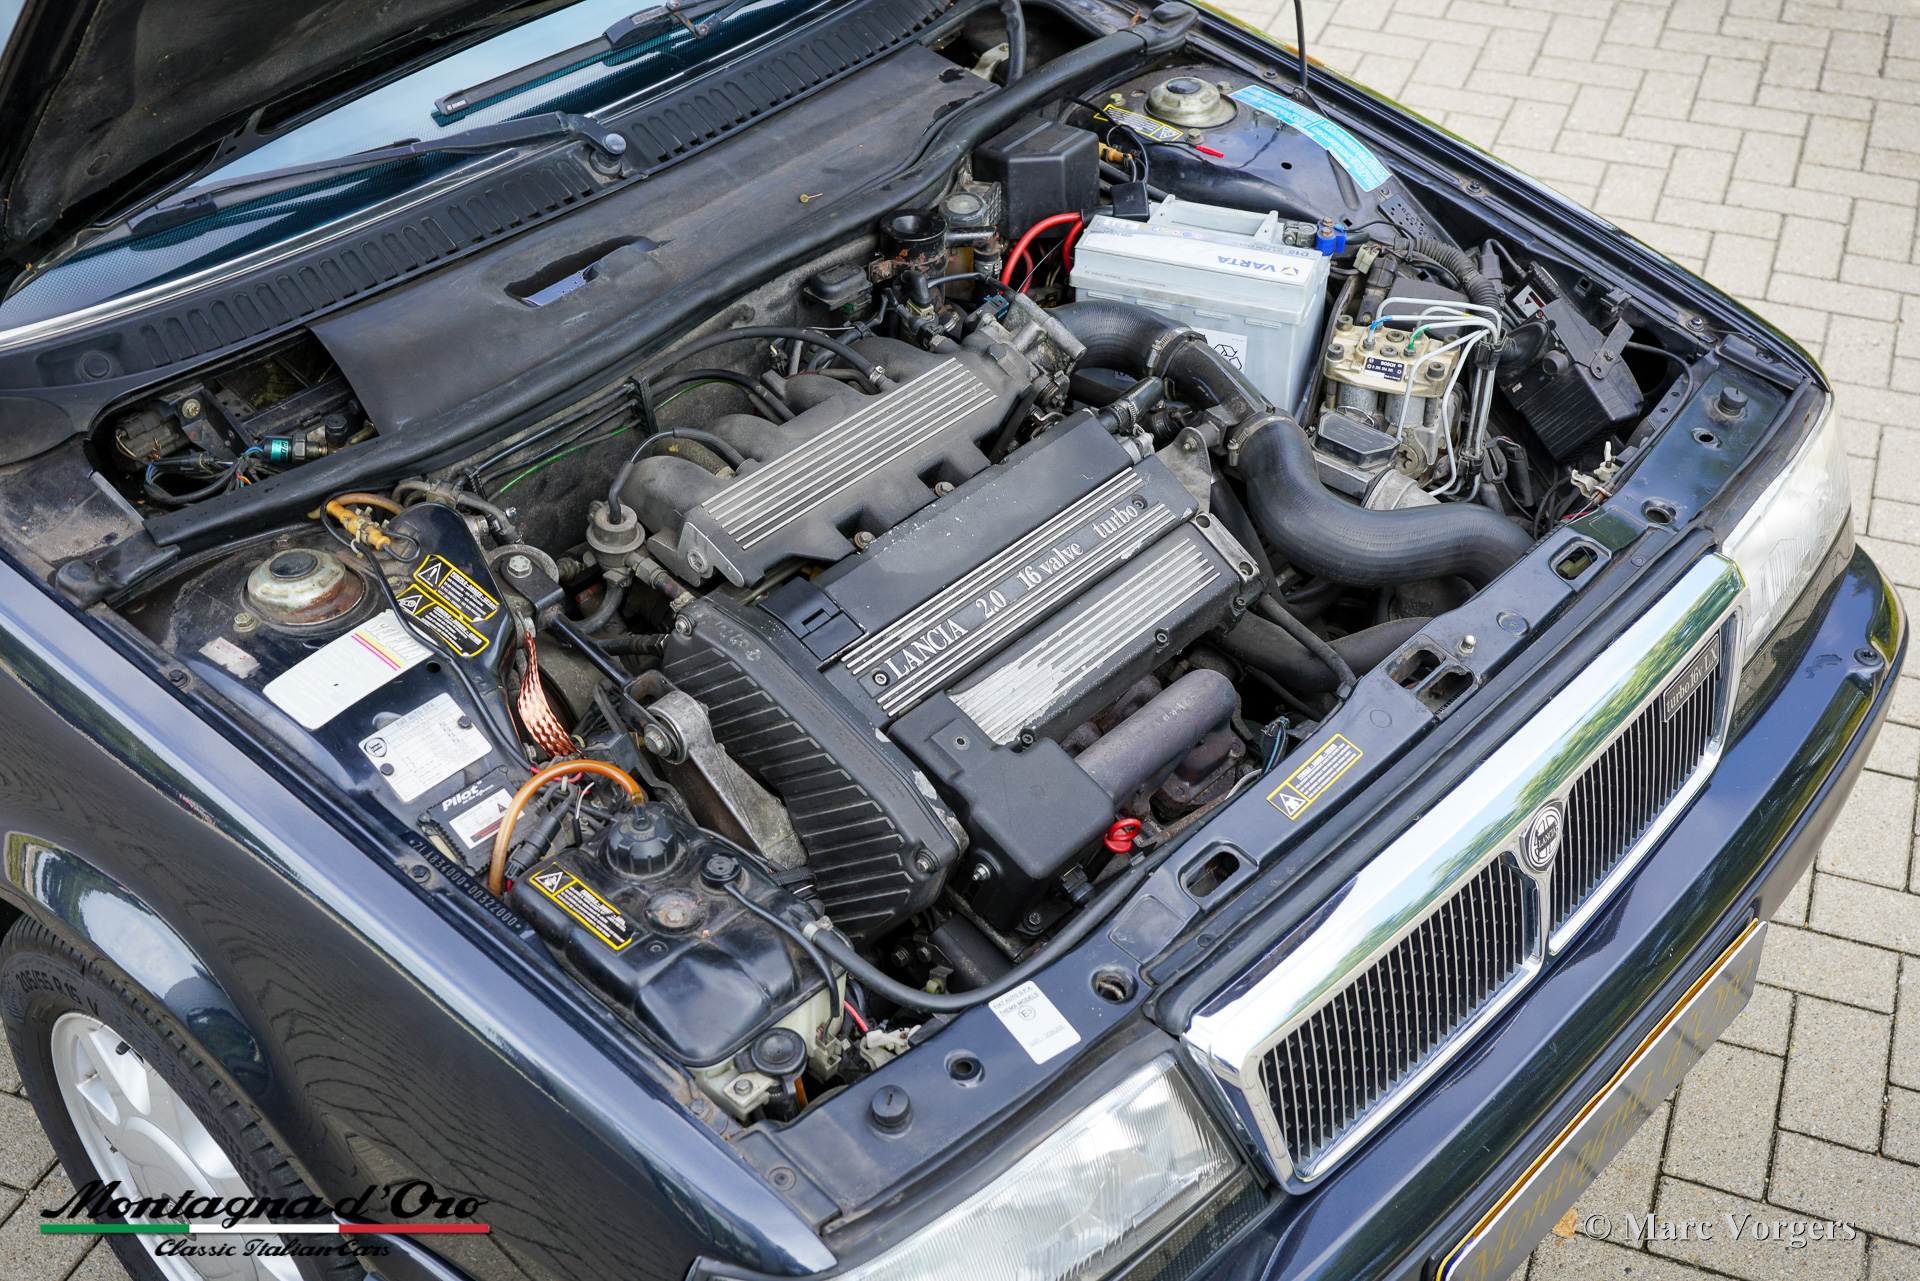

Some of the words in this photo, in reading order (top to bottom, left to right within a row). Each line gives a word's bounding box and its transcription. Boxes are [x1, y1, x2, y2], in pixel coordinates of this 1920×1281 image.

[1218, 256, 1276, 272] VARTA
[884, 618, 968, 679] LANCIA
[976, 588, 1007, 619] 2.0
[1016, 565, 1042, 590] 16
[1038, 541, 1084, 575] valve
[1090, 503, 1138, 539] turbo
[1666, 682, 1690, 712] turbo
[1690, 666, 1703, 688] 16v
[1704, 644, 1718, 672] LX
[408, 710, 422, 720] AUTO
[442, 784, 478, 812] Pilot
[16, 969, 54, 994] 205/55
[64, 982, 83, 1006] 15
[994, 1000, 1005, 1009] FIAT
[1005, 994, 1018, 1003] AUTO
[1000, 1004, 1016, 1016] THEMA
[1017, 992, 1040, 1006] MODELS
